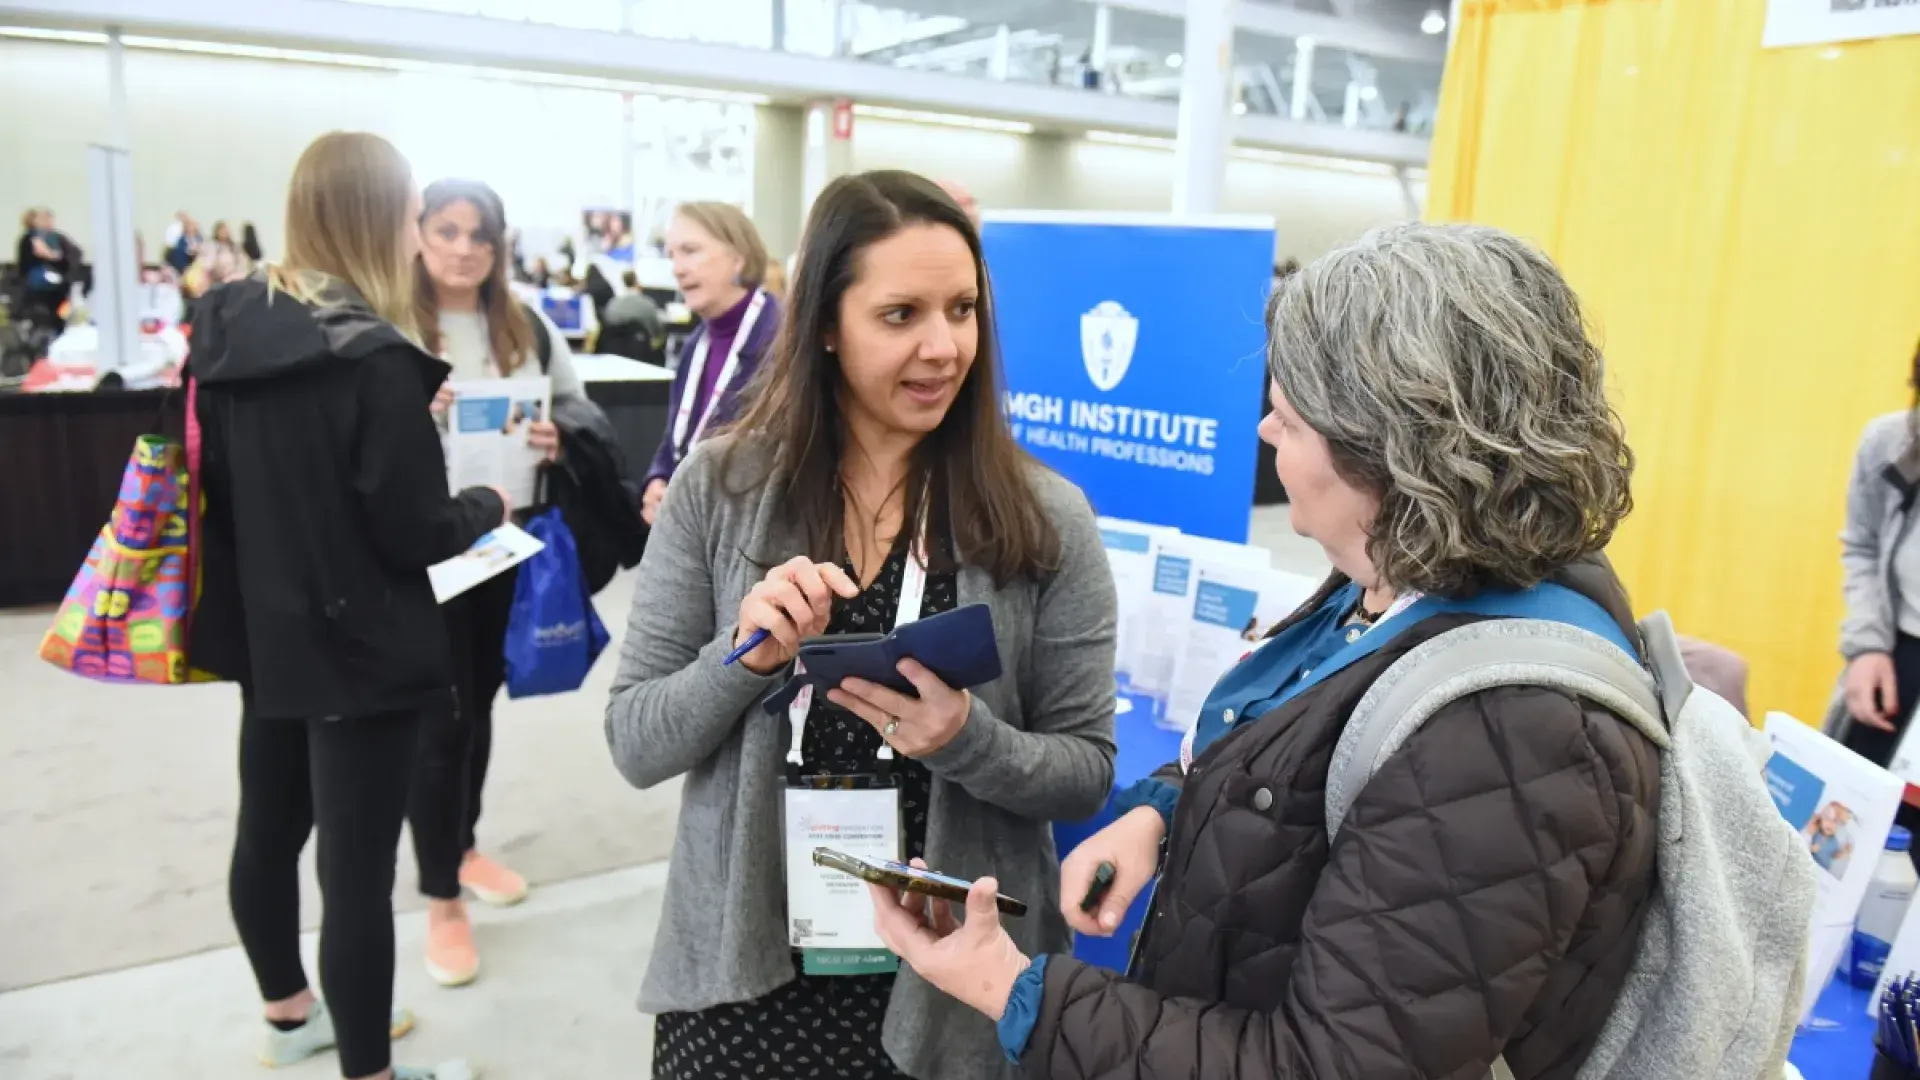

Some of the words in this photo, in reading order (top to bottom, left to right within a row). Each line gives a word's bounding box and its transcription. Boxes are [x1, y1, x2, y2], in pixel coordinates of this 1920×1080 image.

[1002, 391, 1063, 424] MGH
[1070, 400, 1218, 449] INSTITUTE
[1026, 425, 1088, 453] HEALTH
[1091, 437, 1215, 476] PROFESSIONS
